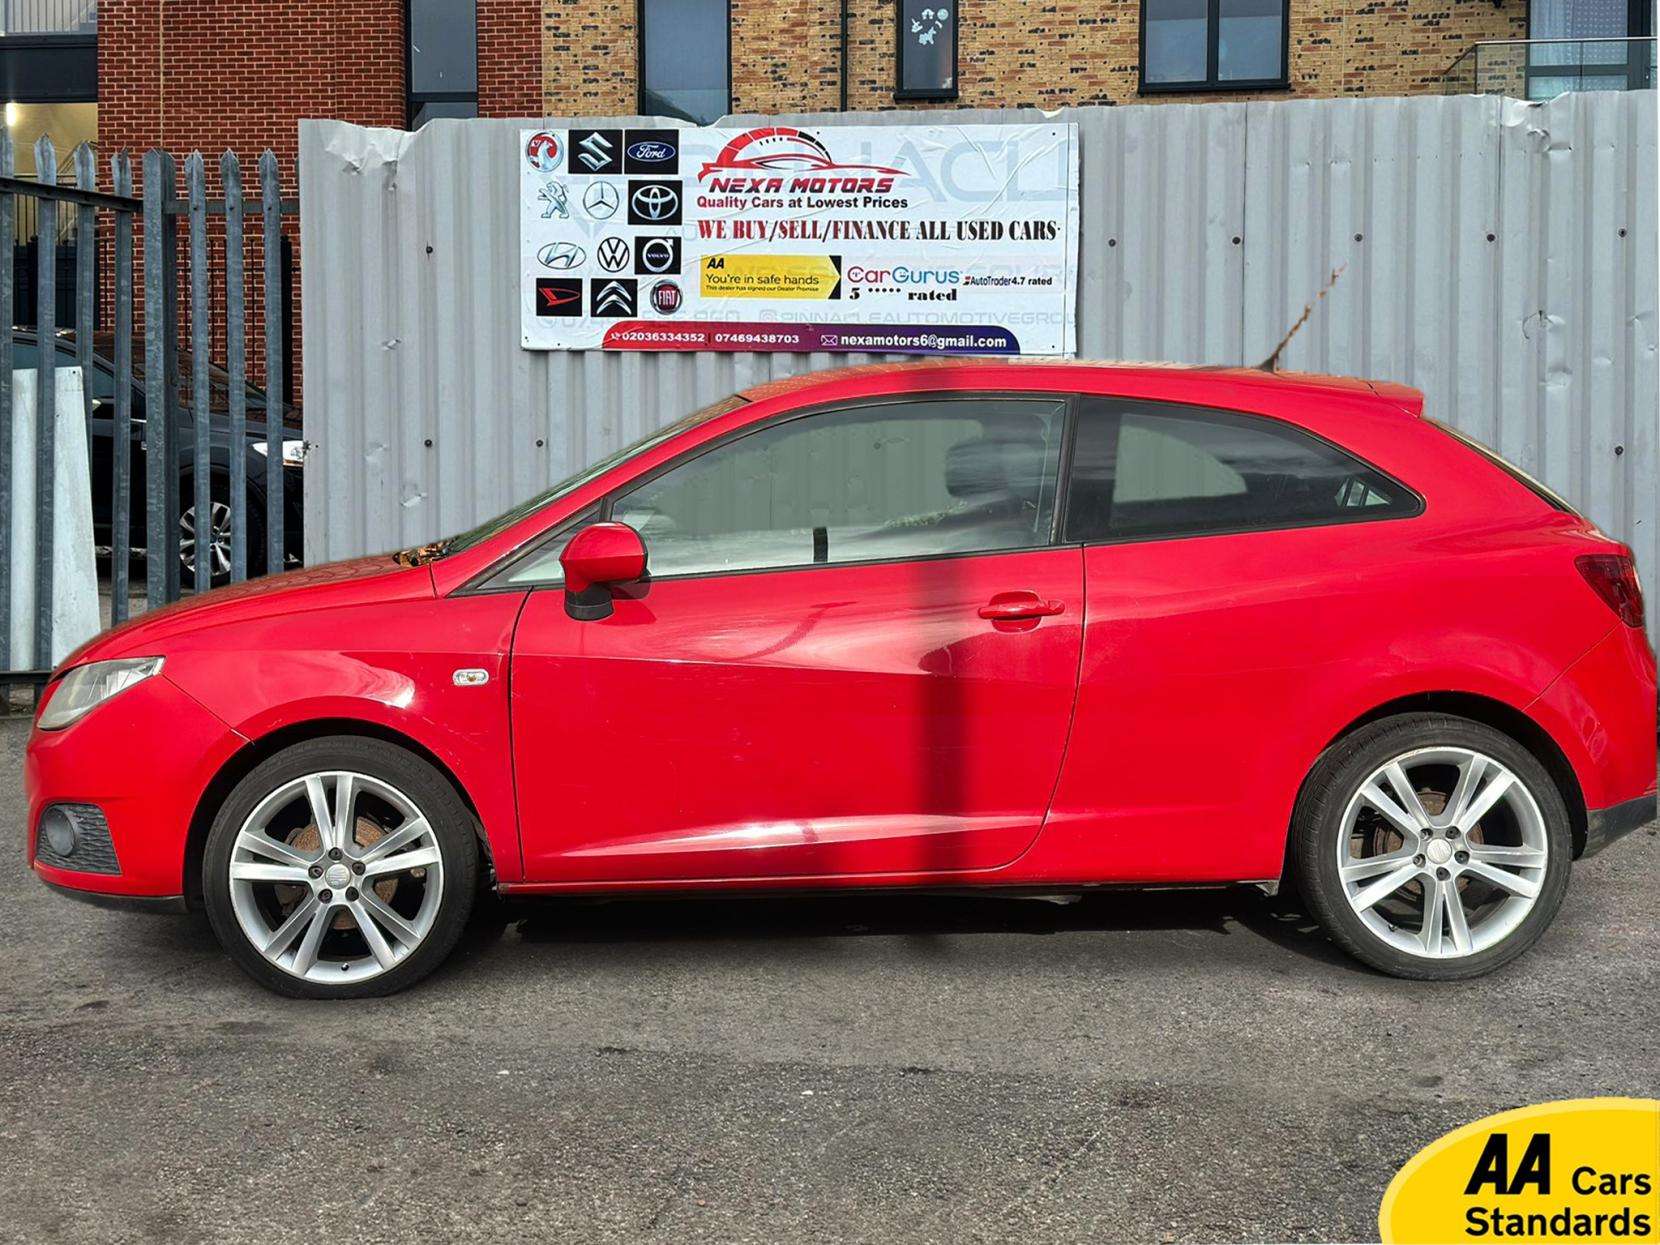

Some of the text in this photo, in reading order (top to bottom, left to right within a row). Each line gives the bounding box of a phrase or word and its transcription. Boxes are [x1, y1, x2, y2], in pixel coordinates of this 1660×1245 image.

[636, 145, 666, 159] Ford
[709, 178, 894, 193] NEXA MOTORS
[697, 195, 908, 210] Quality Cars at Lowest Prices
[697, 219, 727, 239] WE
[916, 220, 951, 240] ALL
[957, 220, 1004, 240] USED
[1008, 220, 1057, 240] CARS
[707, 257, 725, 269] AA
[706, 274, 820, 285] You're in safe hands
[847, 265, 960, 284] CarGurus
[1028, 277, 1052, 286] rated
[658, 290, 676, 305] FIAT
[849, 287, 958, 301] 5 rated
[715, 333, 800, 344] 07469438703
[841, 334, 1007, 349] nexamotors6@gmail.com
